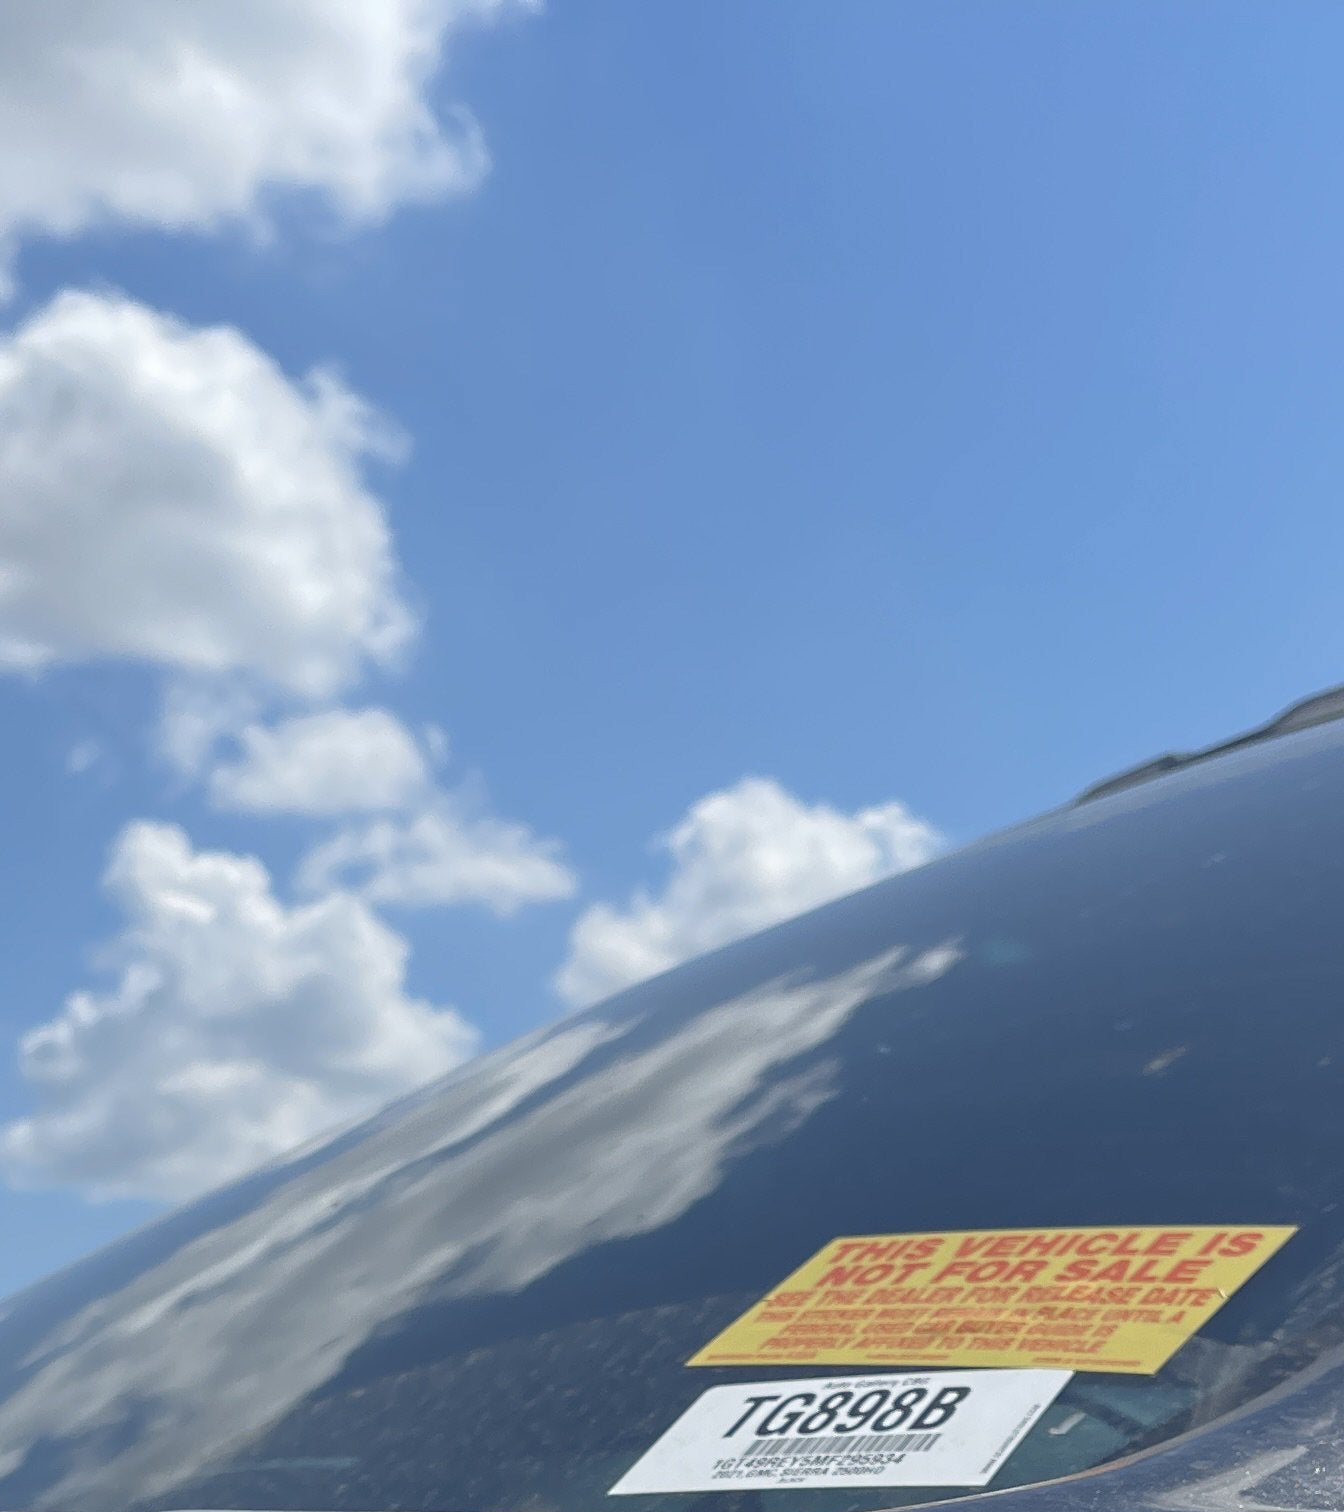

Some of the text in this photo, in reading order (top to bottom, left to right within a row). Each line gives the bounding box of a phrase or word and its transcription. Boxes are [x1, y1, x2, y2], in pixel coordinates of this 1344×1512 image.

[830, 1232, 1263, 1264] THIS VEHICLE IS
[816, 1259, 1213, 1288] NOT FOR SALE
[1139, 1287, 1219, 1306] DATE
[723, 1387, 971, 1438] TG898B
[714, 1454, 906, 1469] 1GT49REY5MF295934
